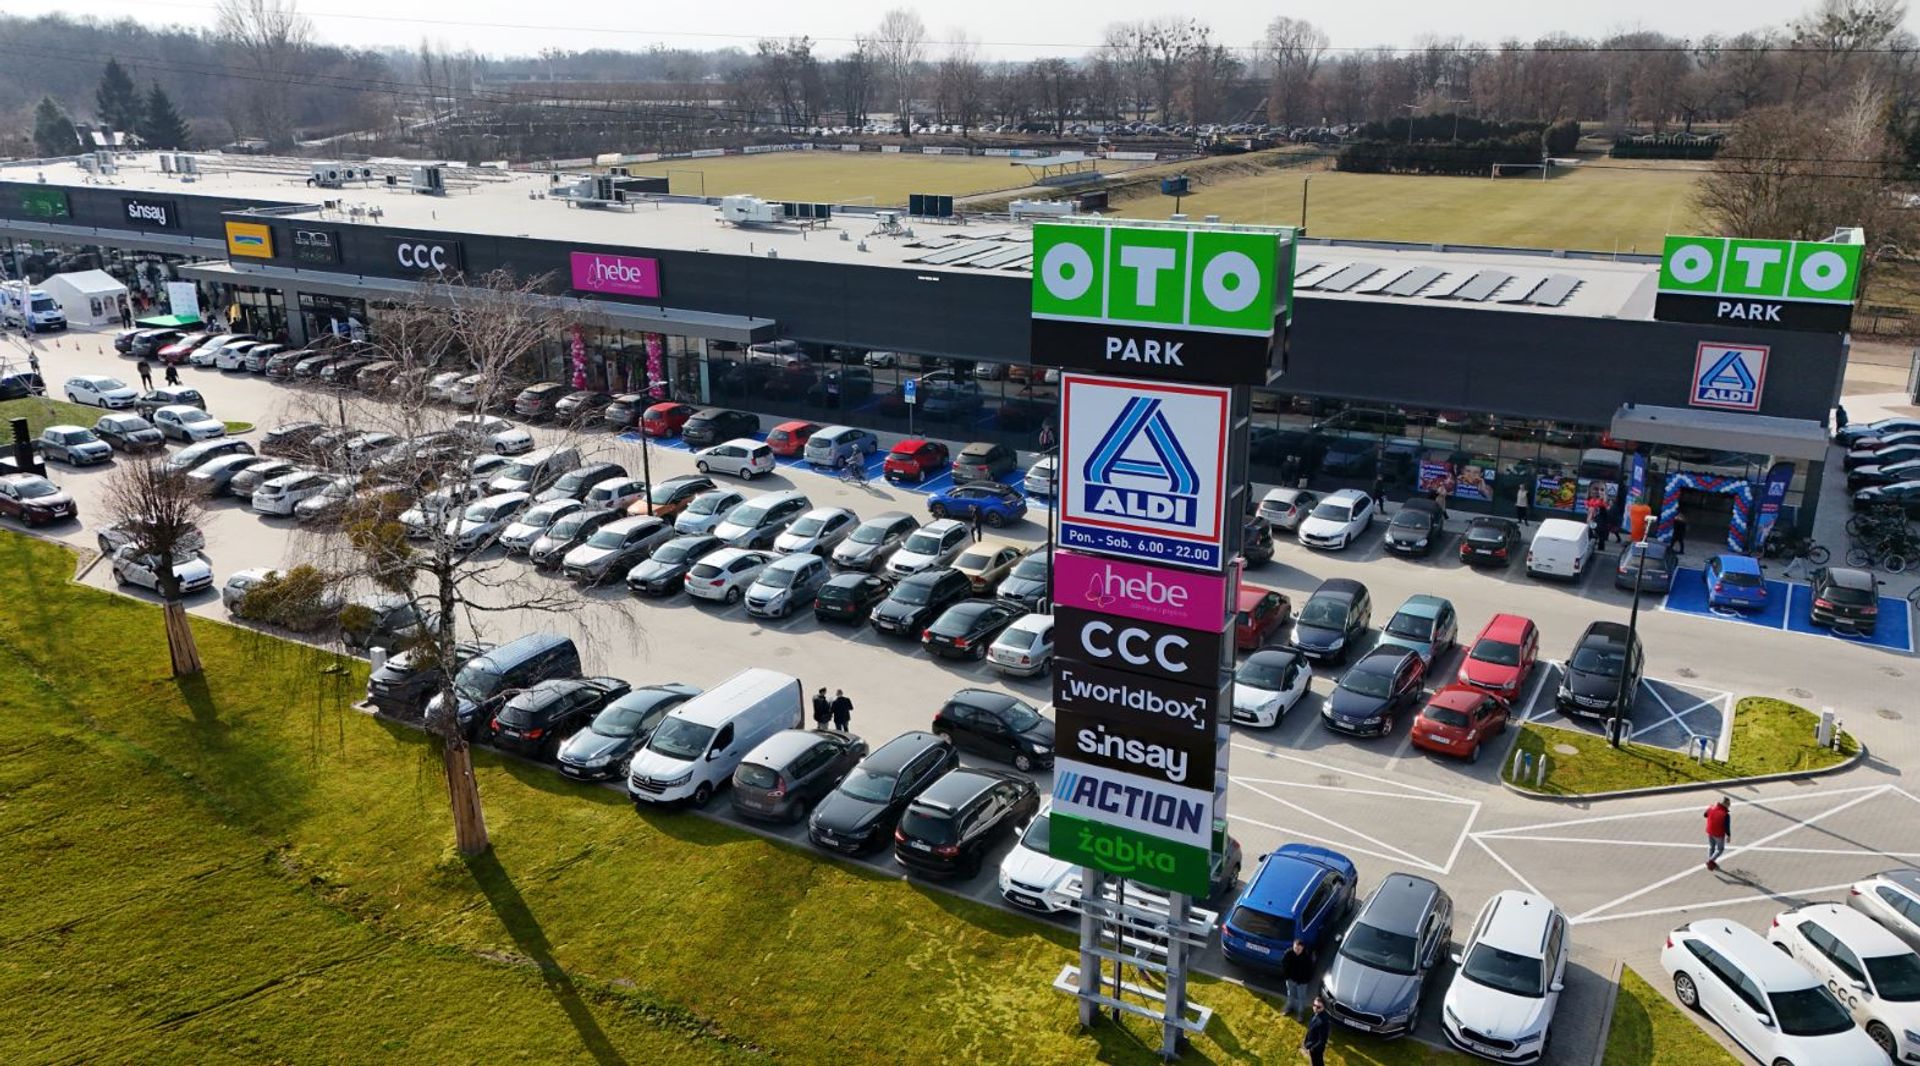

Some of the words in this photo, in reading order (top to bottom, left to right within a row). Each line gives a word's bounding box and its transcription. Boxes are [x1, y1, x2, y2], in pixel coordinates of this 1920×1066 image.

[128, 201, 166, 226] sinsay
[398, 243, 447, 273] CCC
[596, 257, 641, 283] hebe
[1669, 245, 1847, 292] OTO
[1041, 242, 1260, 313] OTO
[1717, 301, 1782, 322] PARK
[1106, 336, 1184, 366] PARK
[1702, 388, 1750, 402] ALDI
[1096, 491, 1187, 523] ALDI
[1069, 530, 1095, 543] Pon.
[1106, 535, 1132, 549] Sob.
[1138, 539, 1164, 553] 6.00
[1176, 545, 1210, 560] 22.00
[1105, 565, 1189, 608] hebe
[1081, 620, 1189, 672] CCC
[1077, 725, 1188, 781] sinsay
[1073, 776, 1204, 834] ACTION
[1079, 828, 1176, 874] żabka
[1828, 979, 1858, 1010] CCC
